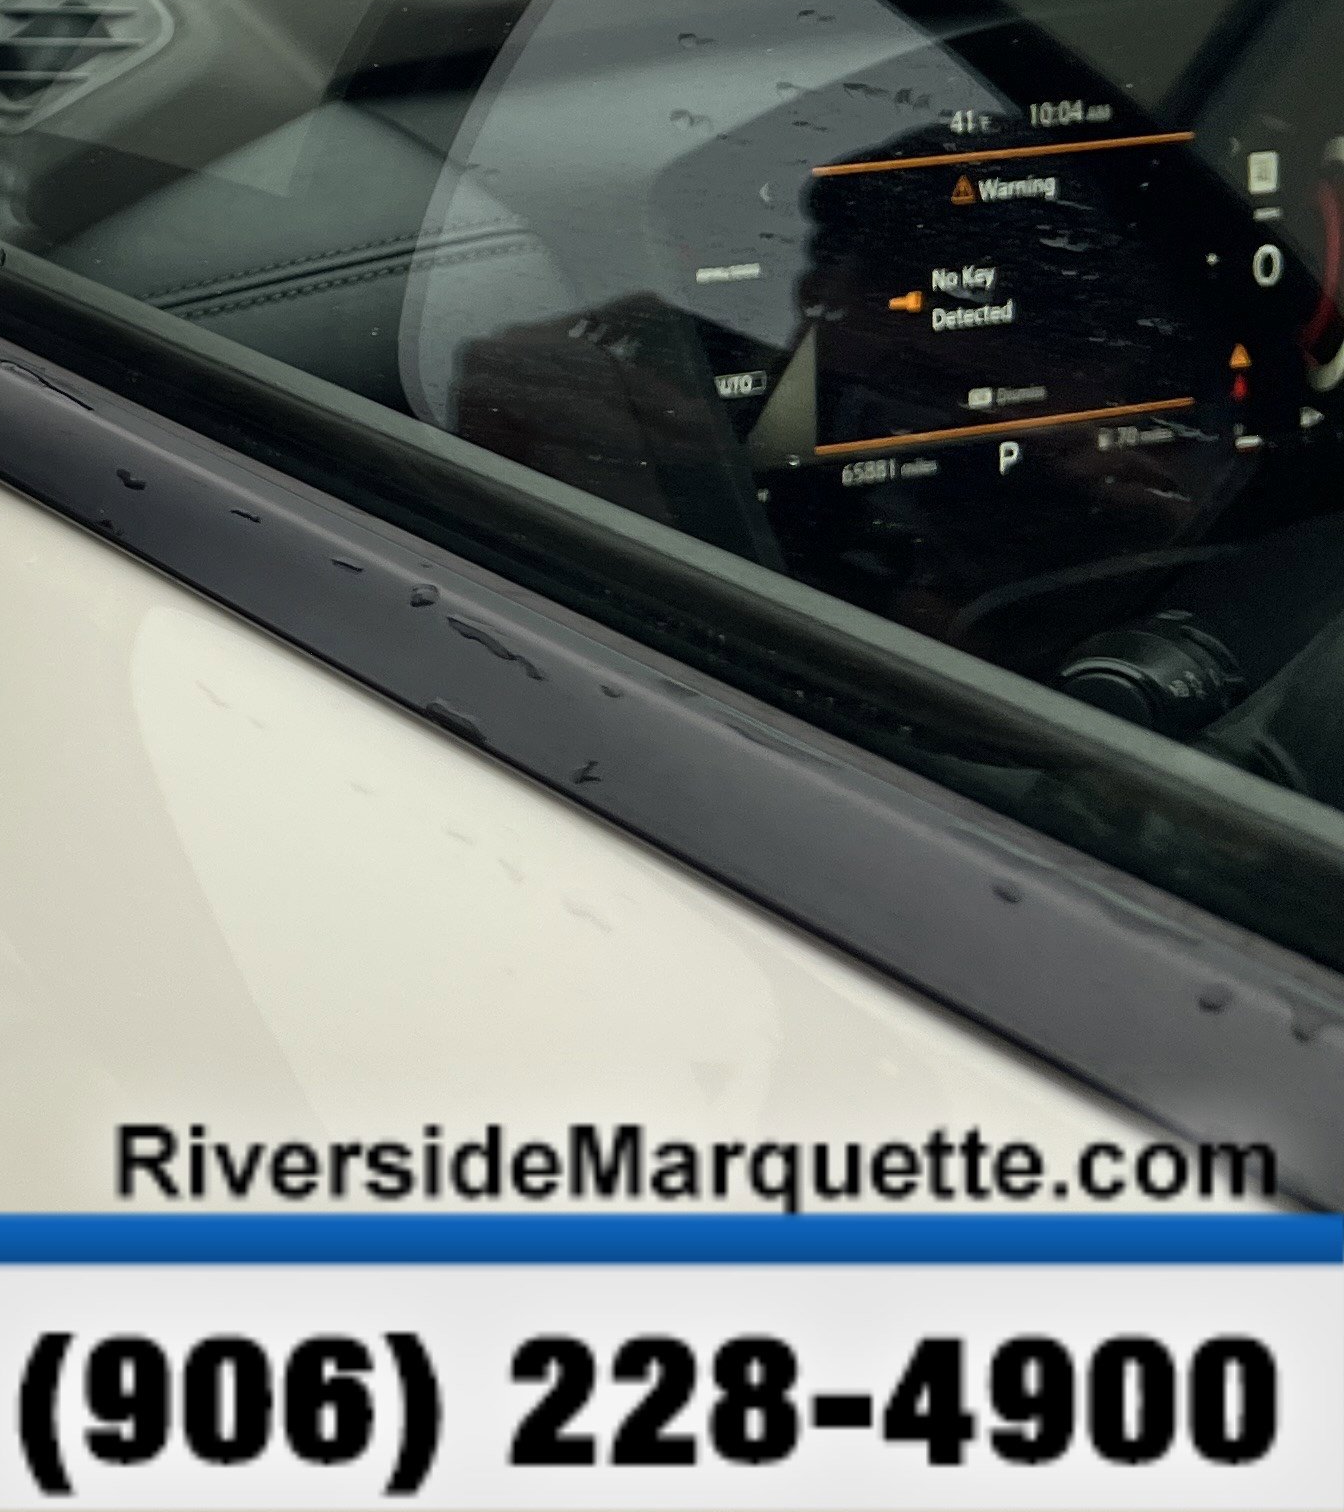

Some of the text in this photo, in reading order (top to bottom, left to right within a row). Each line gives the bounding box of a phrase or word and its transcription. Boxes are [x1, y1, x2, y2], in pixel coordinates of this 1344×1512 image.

[1029, 99, 1083, 128] 10:04
[978, 176, 1057, 203] Warning
[931, 264, 997, 291] No Key
[931, 298, 1016, 332] Detected
[998, 440, 1022, 477] P
